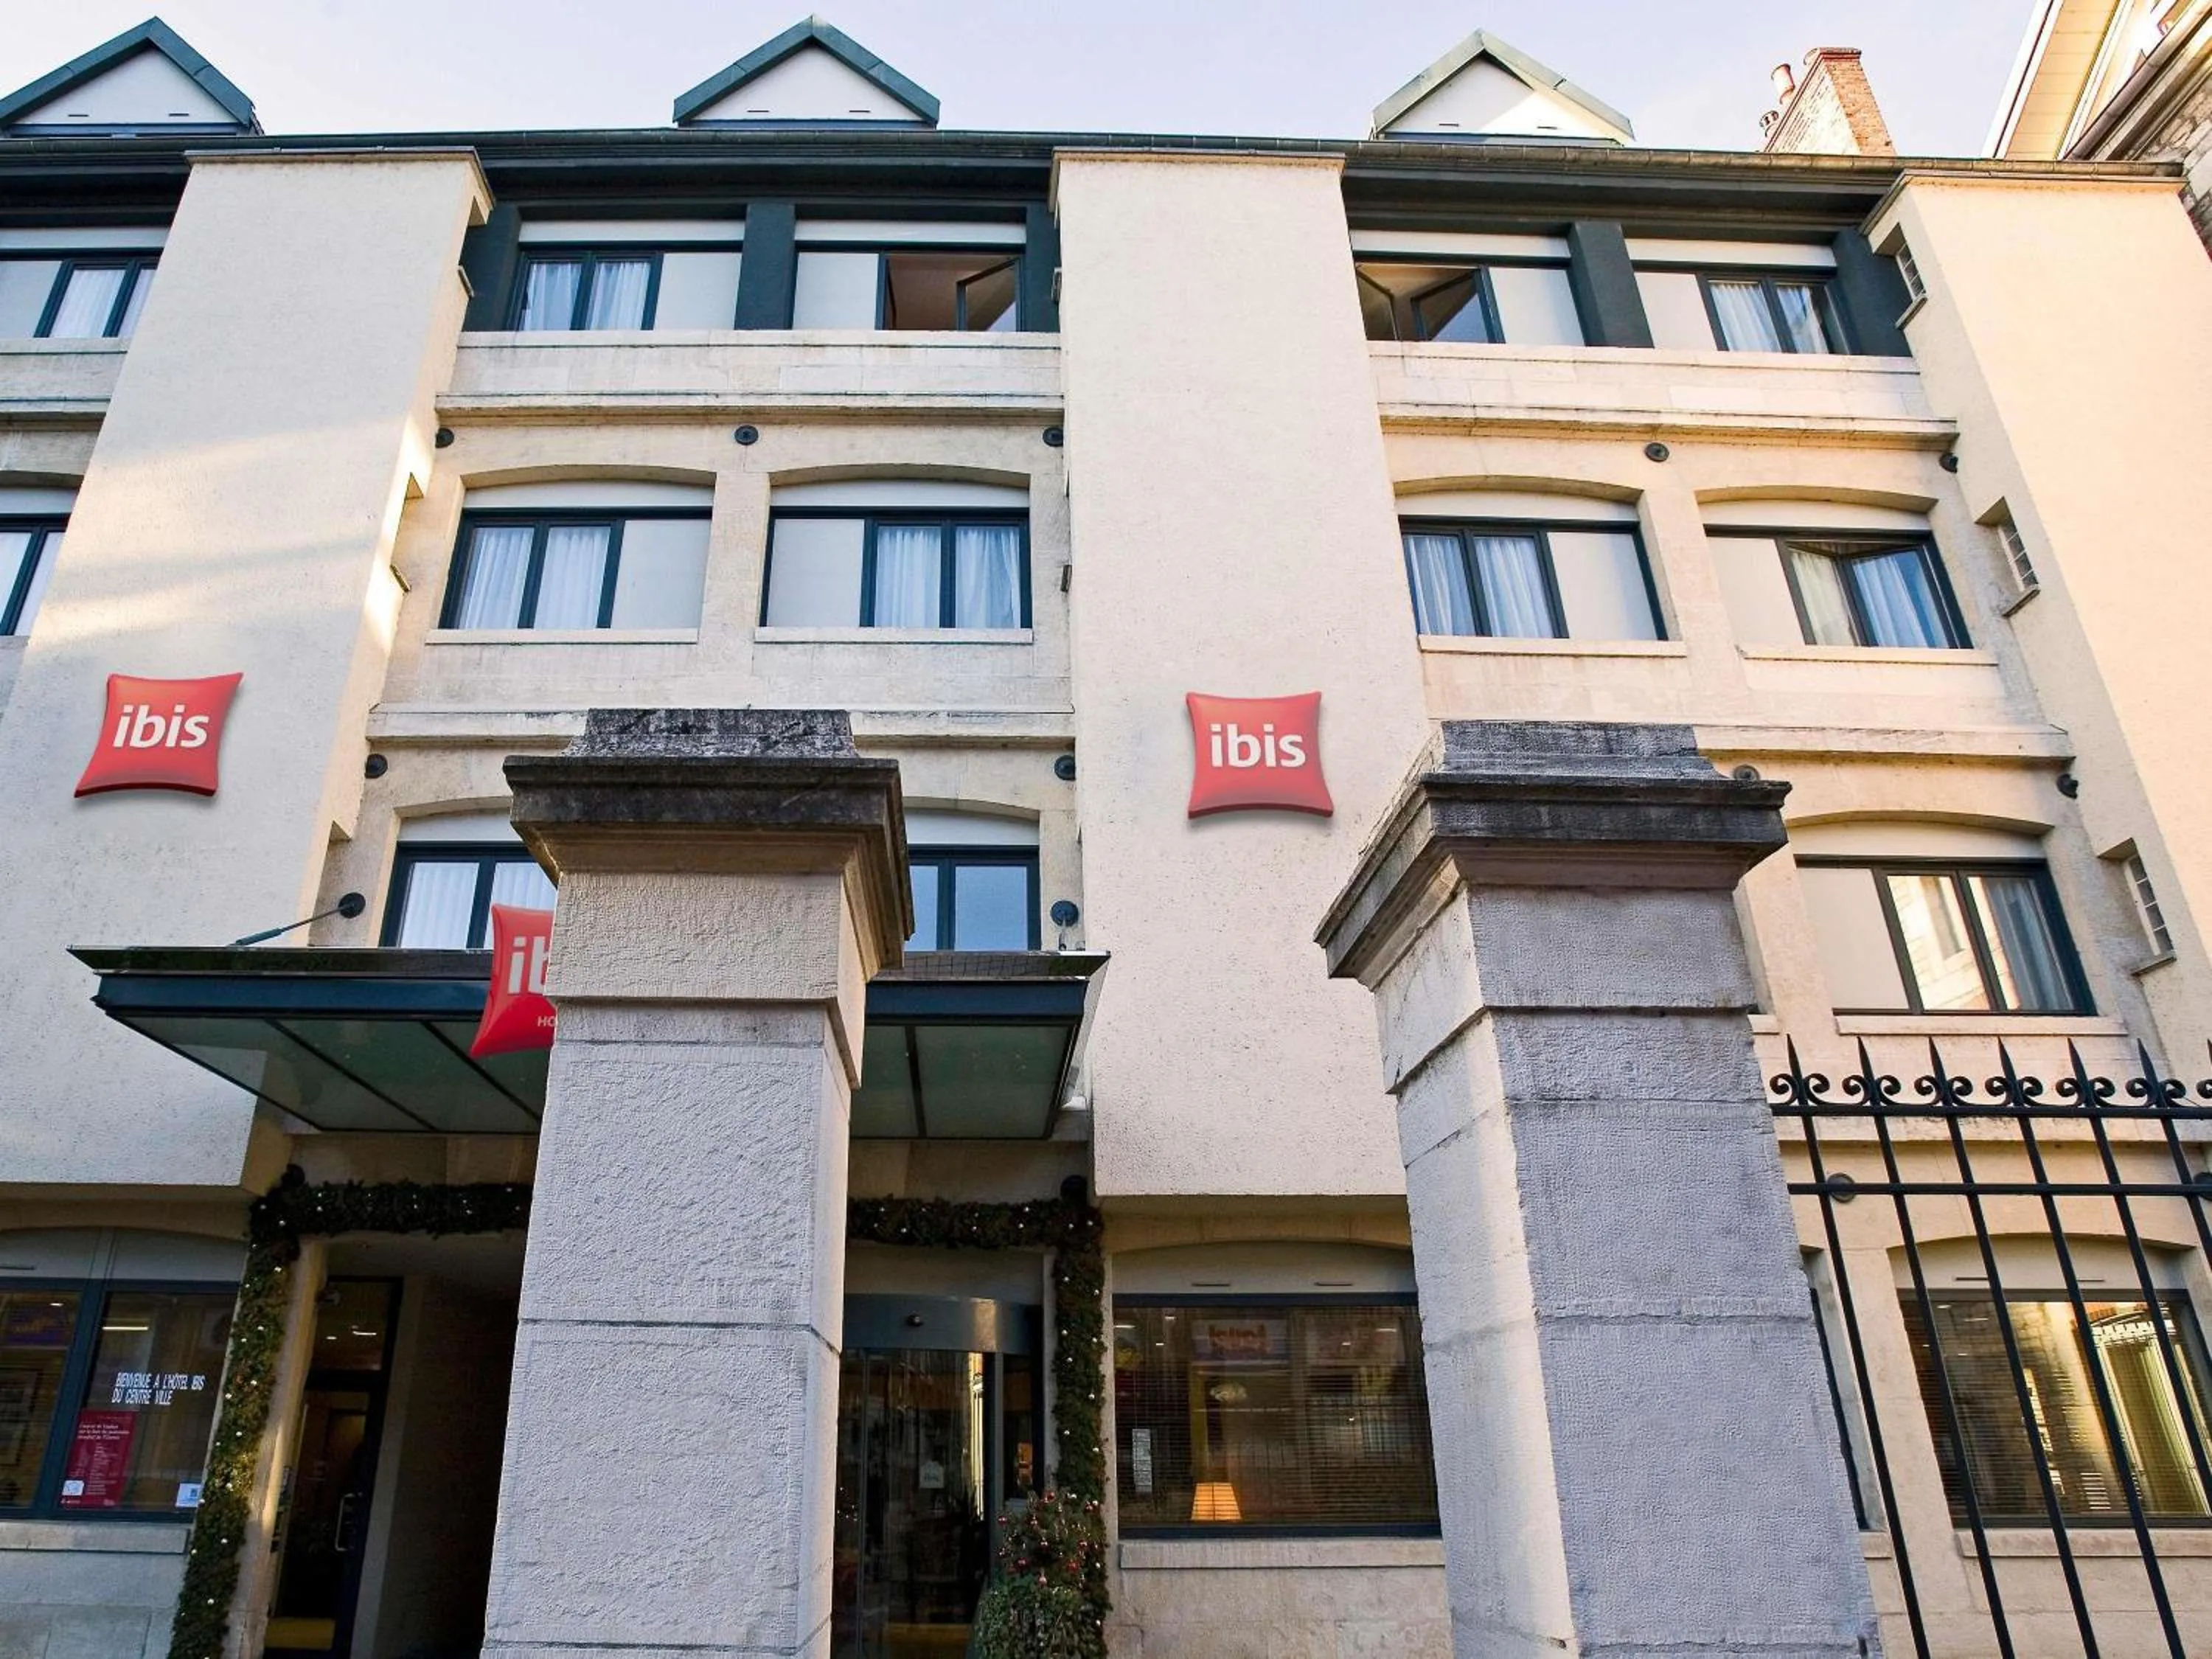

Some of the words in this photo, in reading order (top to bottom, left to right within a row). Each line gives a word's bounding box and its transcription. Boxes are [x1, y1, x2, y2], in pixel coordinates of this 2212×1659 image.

[113, 705, 209, 748] ibis
[1210, 723, 1306, 767] ibis
[111, 1388, 124, 1403] DU
[125, 1389, 152, 1405] CENTRE
[155, 1390, 173, 1405] VILLE
